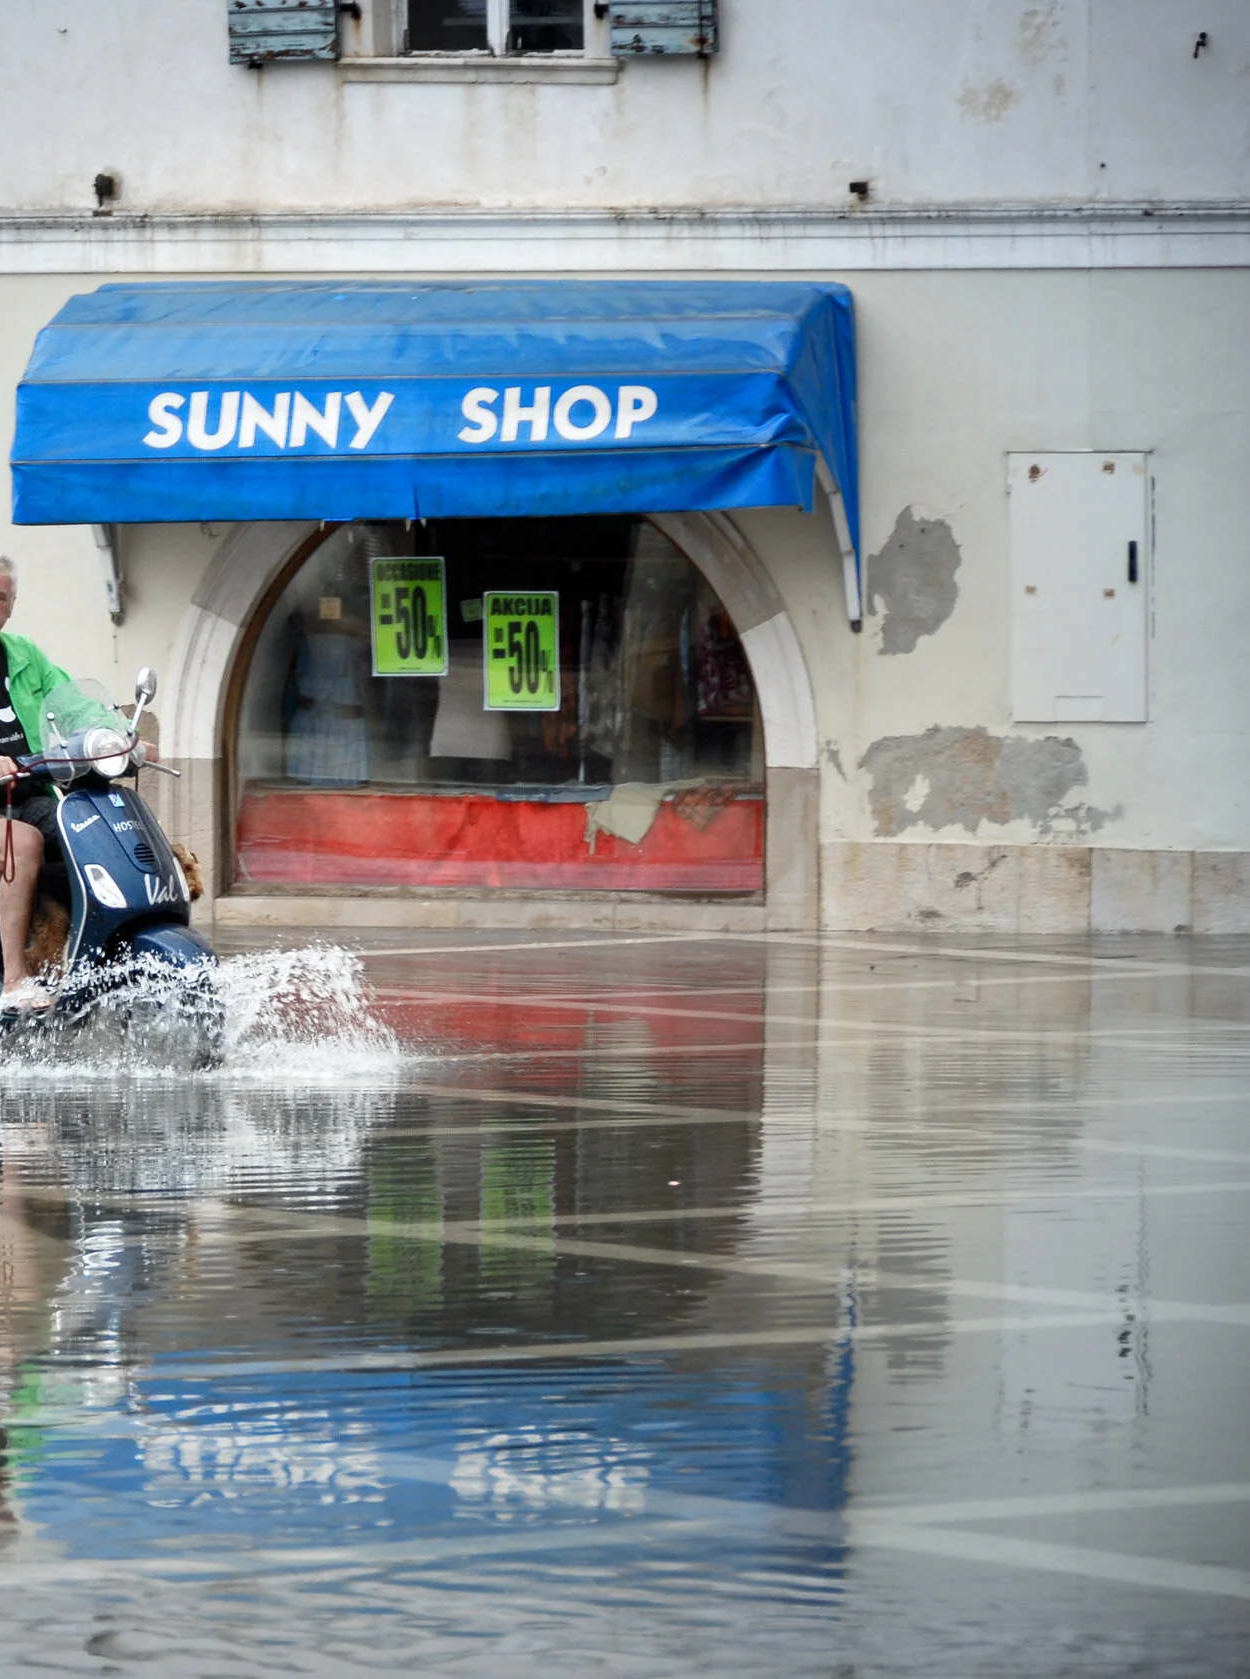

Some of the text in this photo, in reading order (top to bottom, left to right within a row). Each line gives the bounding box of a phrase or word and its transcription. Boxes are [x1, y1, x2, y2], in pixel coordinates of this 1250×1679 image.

[143, 384, 658, 451] SUNNY SHOP
[491, 598, 552, 616] AKCIJA
[70, 815, 100, 833] Vespa
[113, 820, 144, 833] HOSTEL
[144, 873, 178, 905] Val
